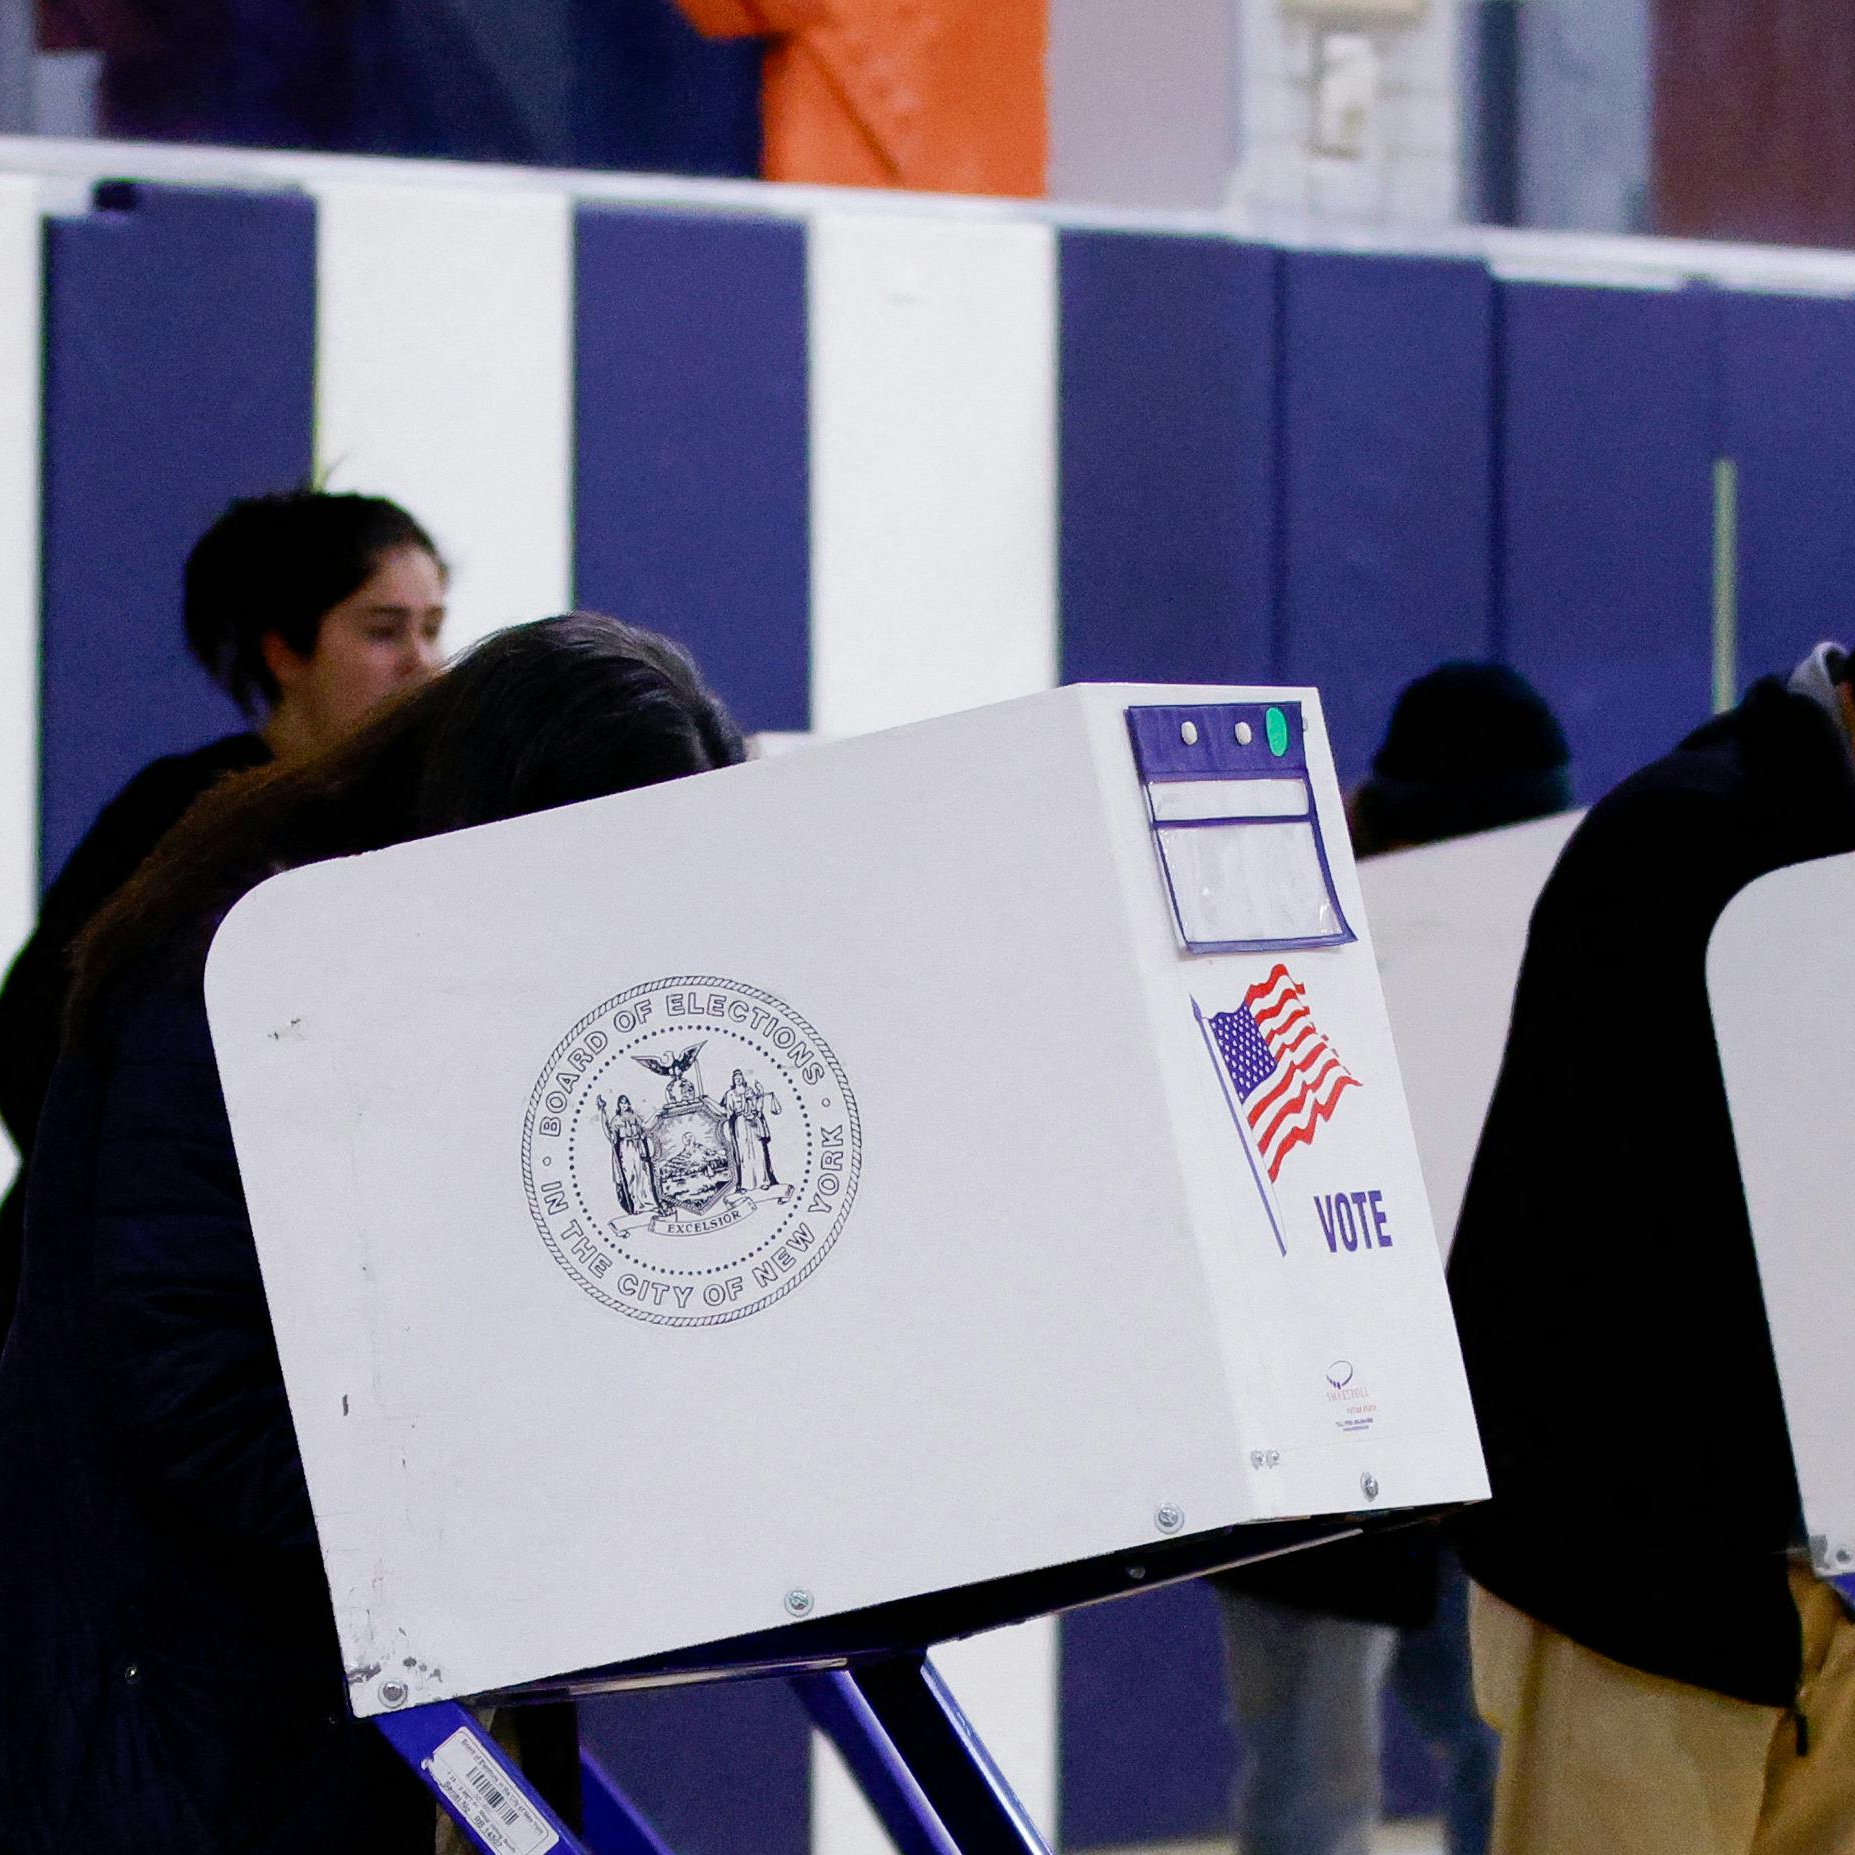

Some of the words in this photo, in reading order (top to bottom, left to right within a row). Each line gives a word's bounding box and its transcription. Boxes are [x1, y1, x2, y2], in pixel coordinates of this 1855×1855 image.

[540, 1030, 608, 1138] BOARD
[614, 999, 652, 1033] OF
[666, 992, 825, 1086] ELECTIONS
[541, 1181, 569, 1215] IN
[560, 1219, 613, 1279] THE
[617, 1273, 694, 1308] CITY
[703, 1277, 744, 1306] OF
[751, 1223, 816, 1288] NEW
[808, 1124, 843, 1214] YORK
[667, 1210, 741, 1233] EXCELSIOR
[1313, 1190, 1393, 1253] VOTE
